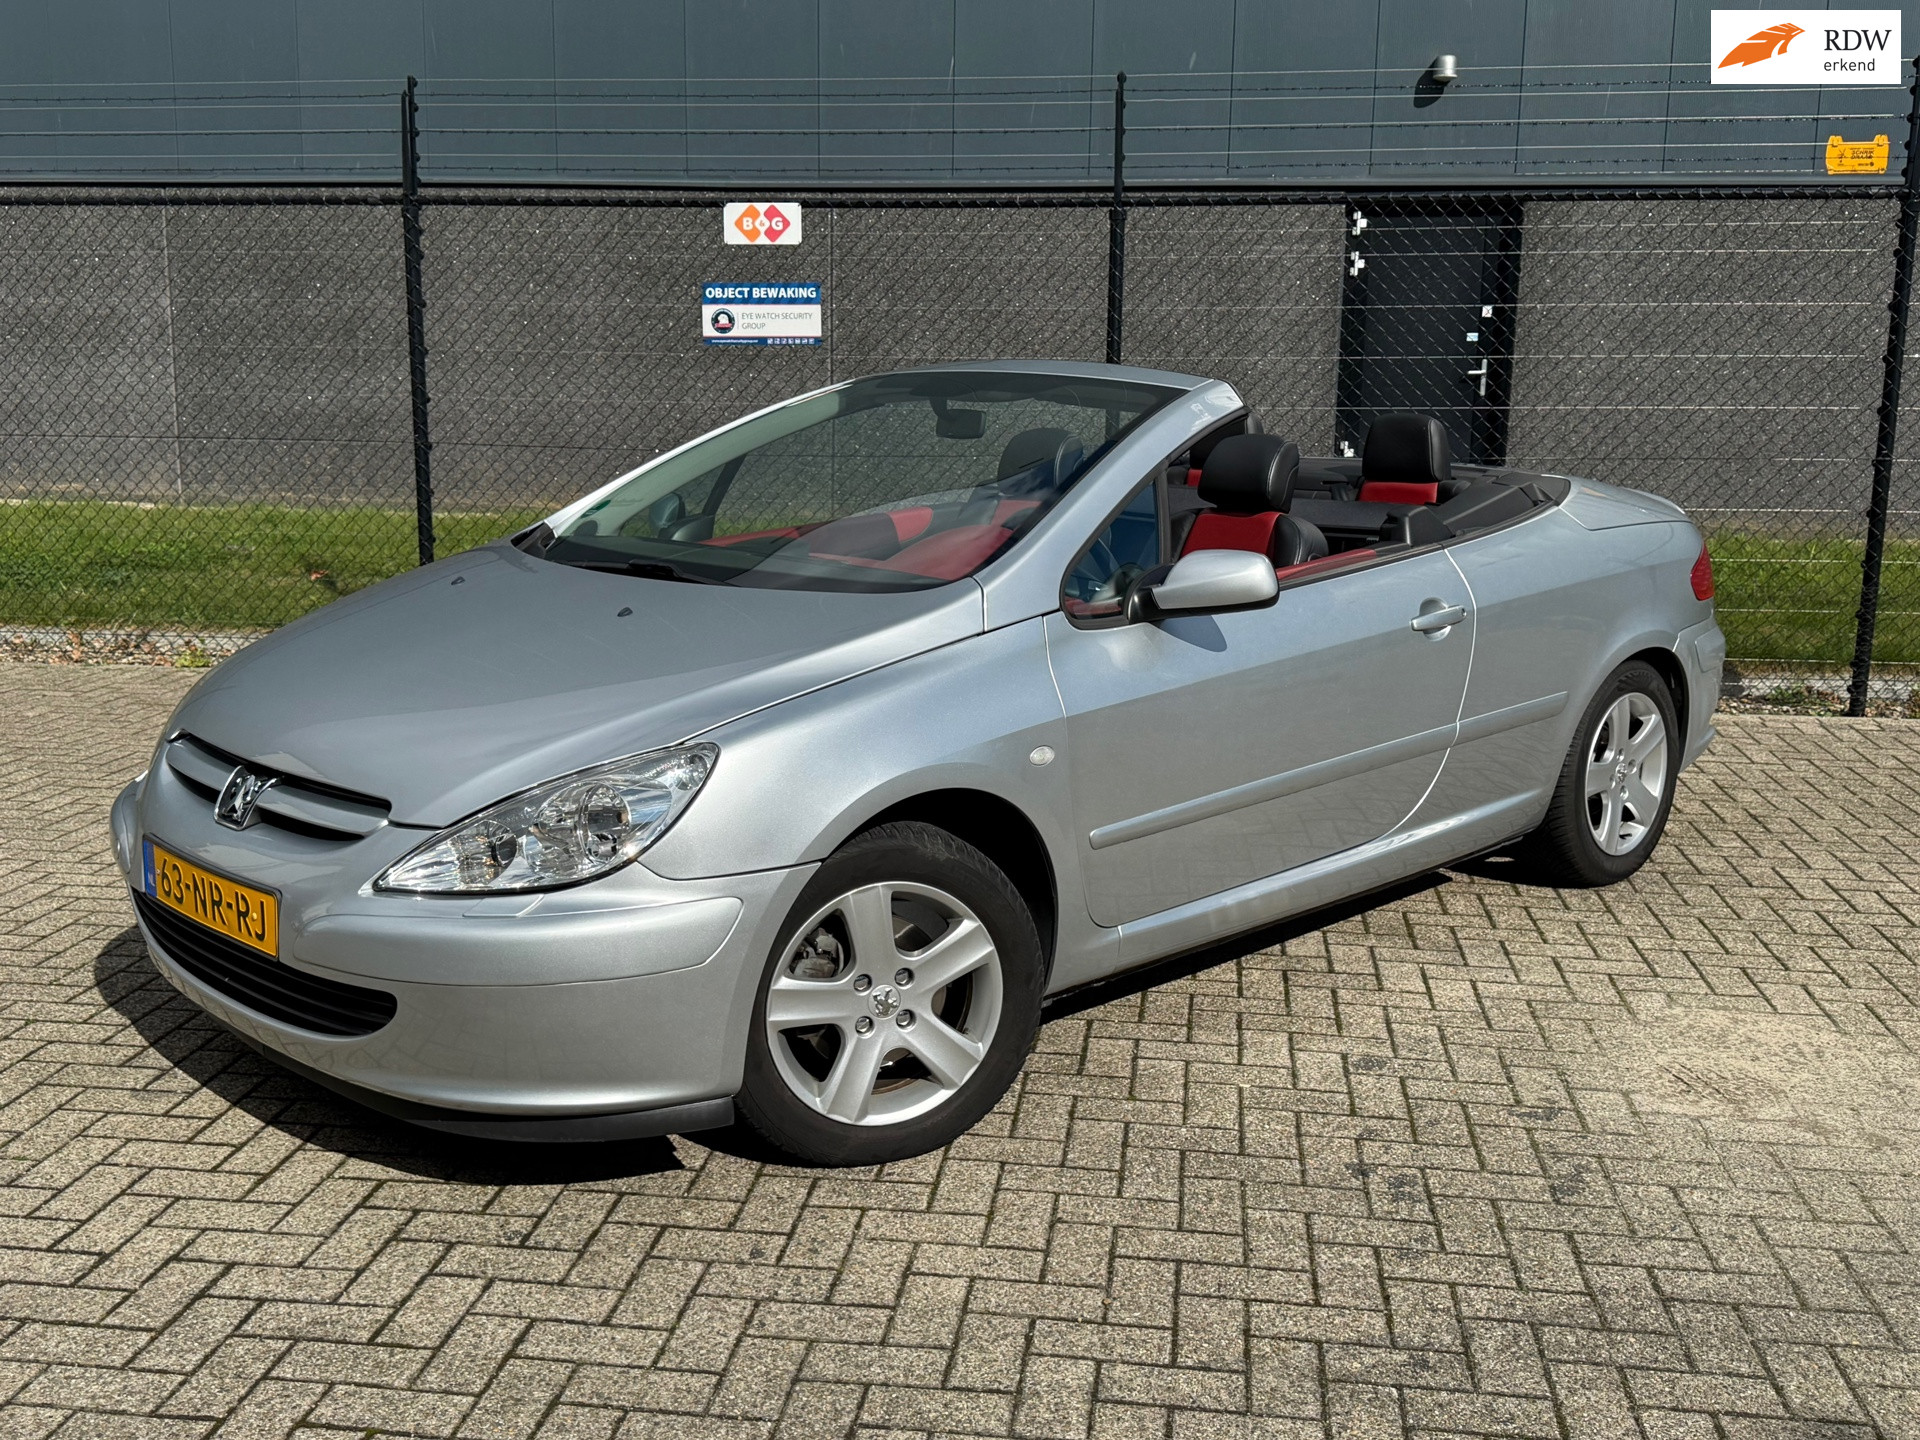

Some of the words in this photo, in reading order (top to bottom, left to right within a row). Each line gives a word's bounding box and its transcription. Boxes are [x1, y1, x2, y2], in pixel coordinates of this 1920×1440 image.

[705, 287, 749, 299] OBJECT
[752, 287, 817, 299] BEWAKING
[161, 857, 267, 942] 63-NR-RJ
